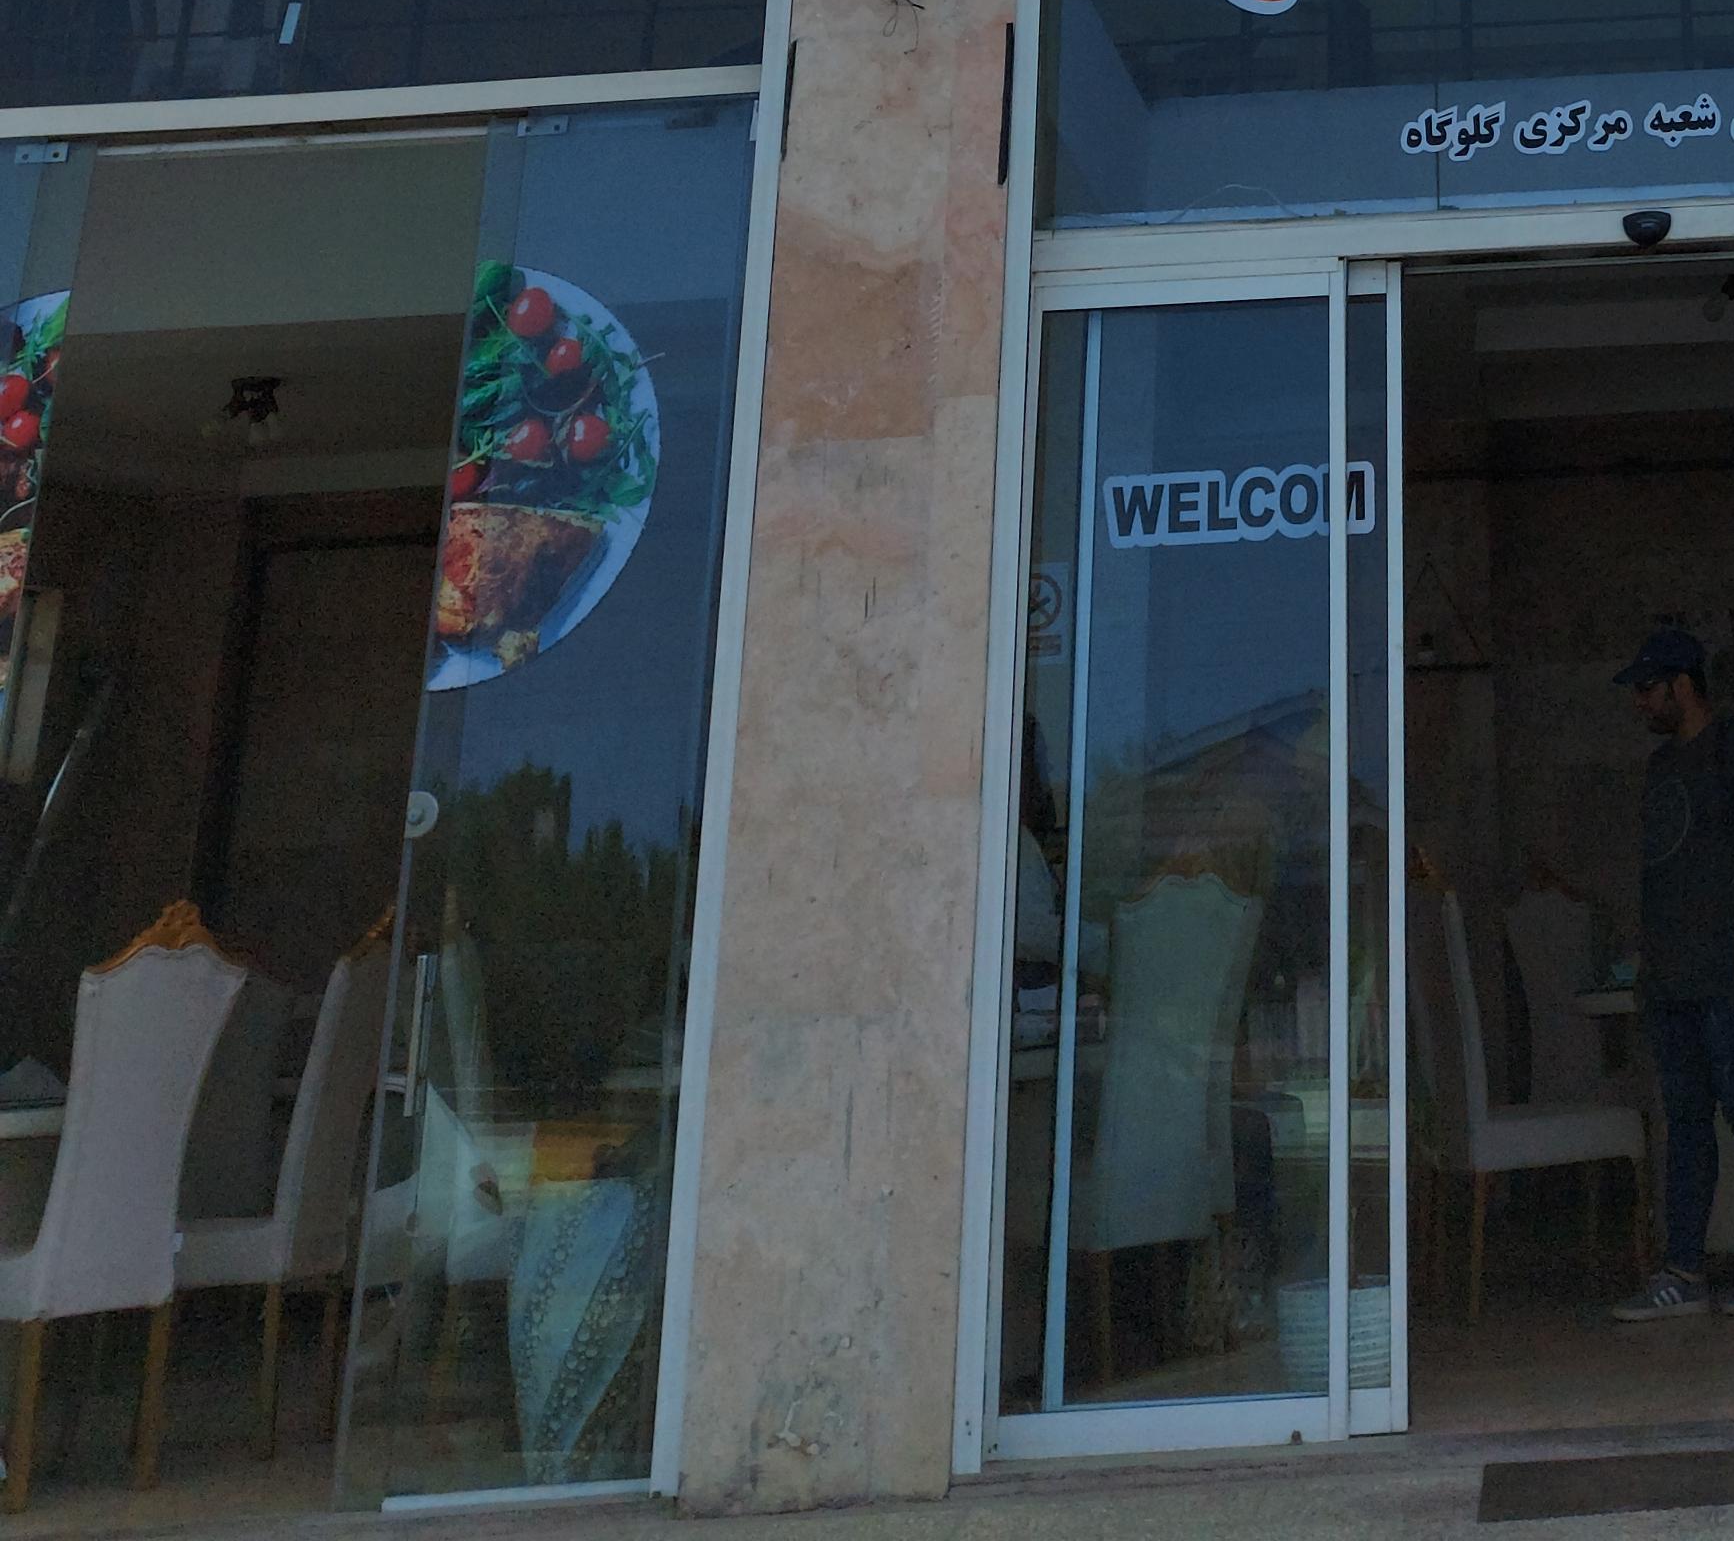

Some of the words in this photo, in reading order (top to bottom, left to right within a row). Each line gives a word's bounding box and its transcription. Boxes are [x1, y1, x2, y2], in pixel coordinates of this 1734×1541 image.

[1405, 110, 1500, 156] گلوگاه
[1519, 105, 1629, 149] مرکزی
[1649, 99, 1718, 143] شعبه
[1112, 470, 1365, 536] WELCOM
